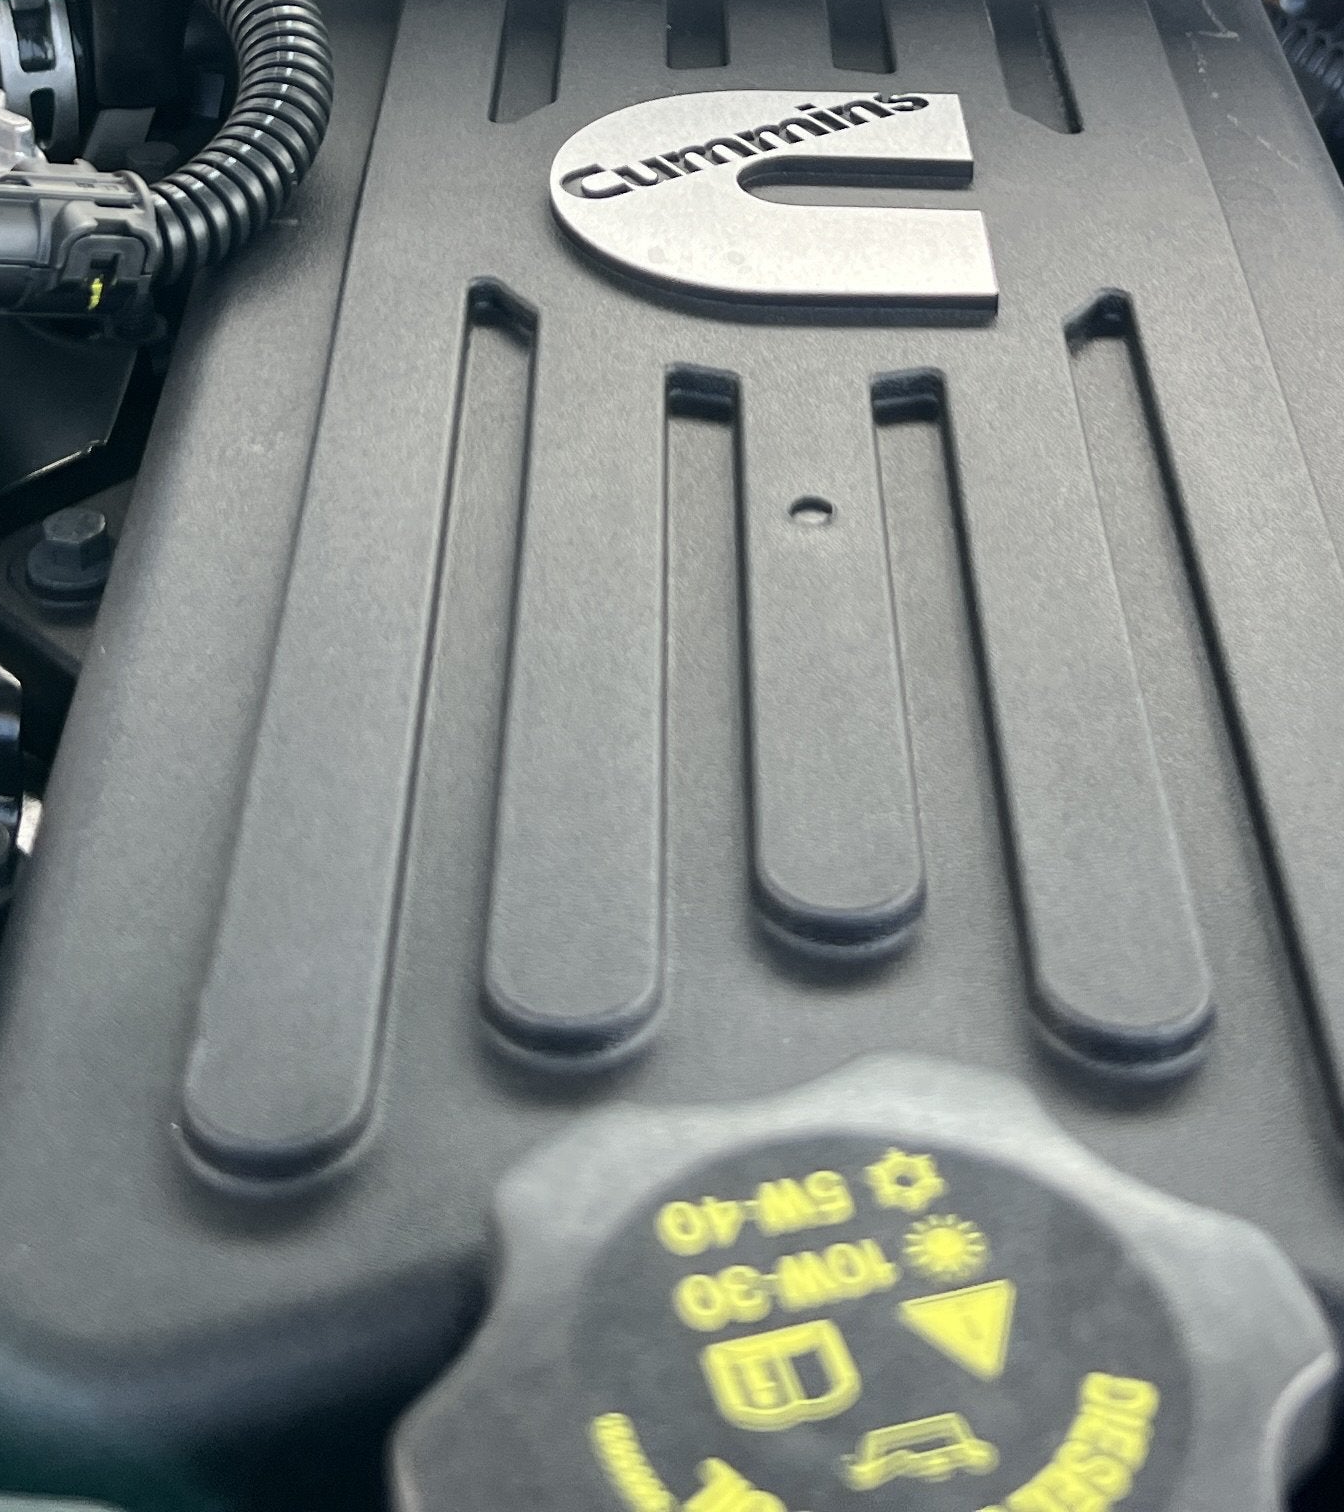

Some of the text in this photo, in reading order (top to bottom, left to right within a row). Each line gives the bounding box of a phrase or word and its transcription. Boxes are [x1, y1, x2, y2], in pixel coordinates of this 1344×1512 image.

[559, 90, 930, 202] Cummins
[654, 1169, 856, 1257] 5W-40
[672, 1238, 899, 1333] 10W-30
